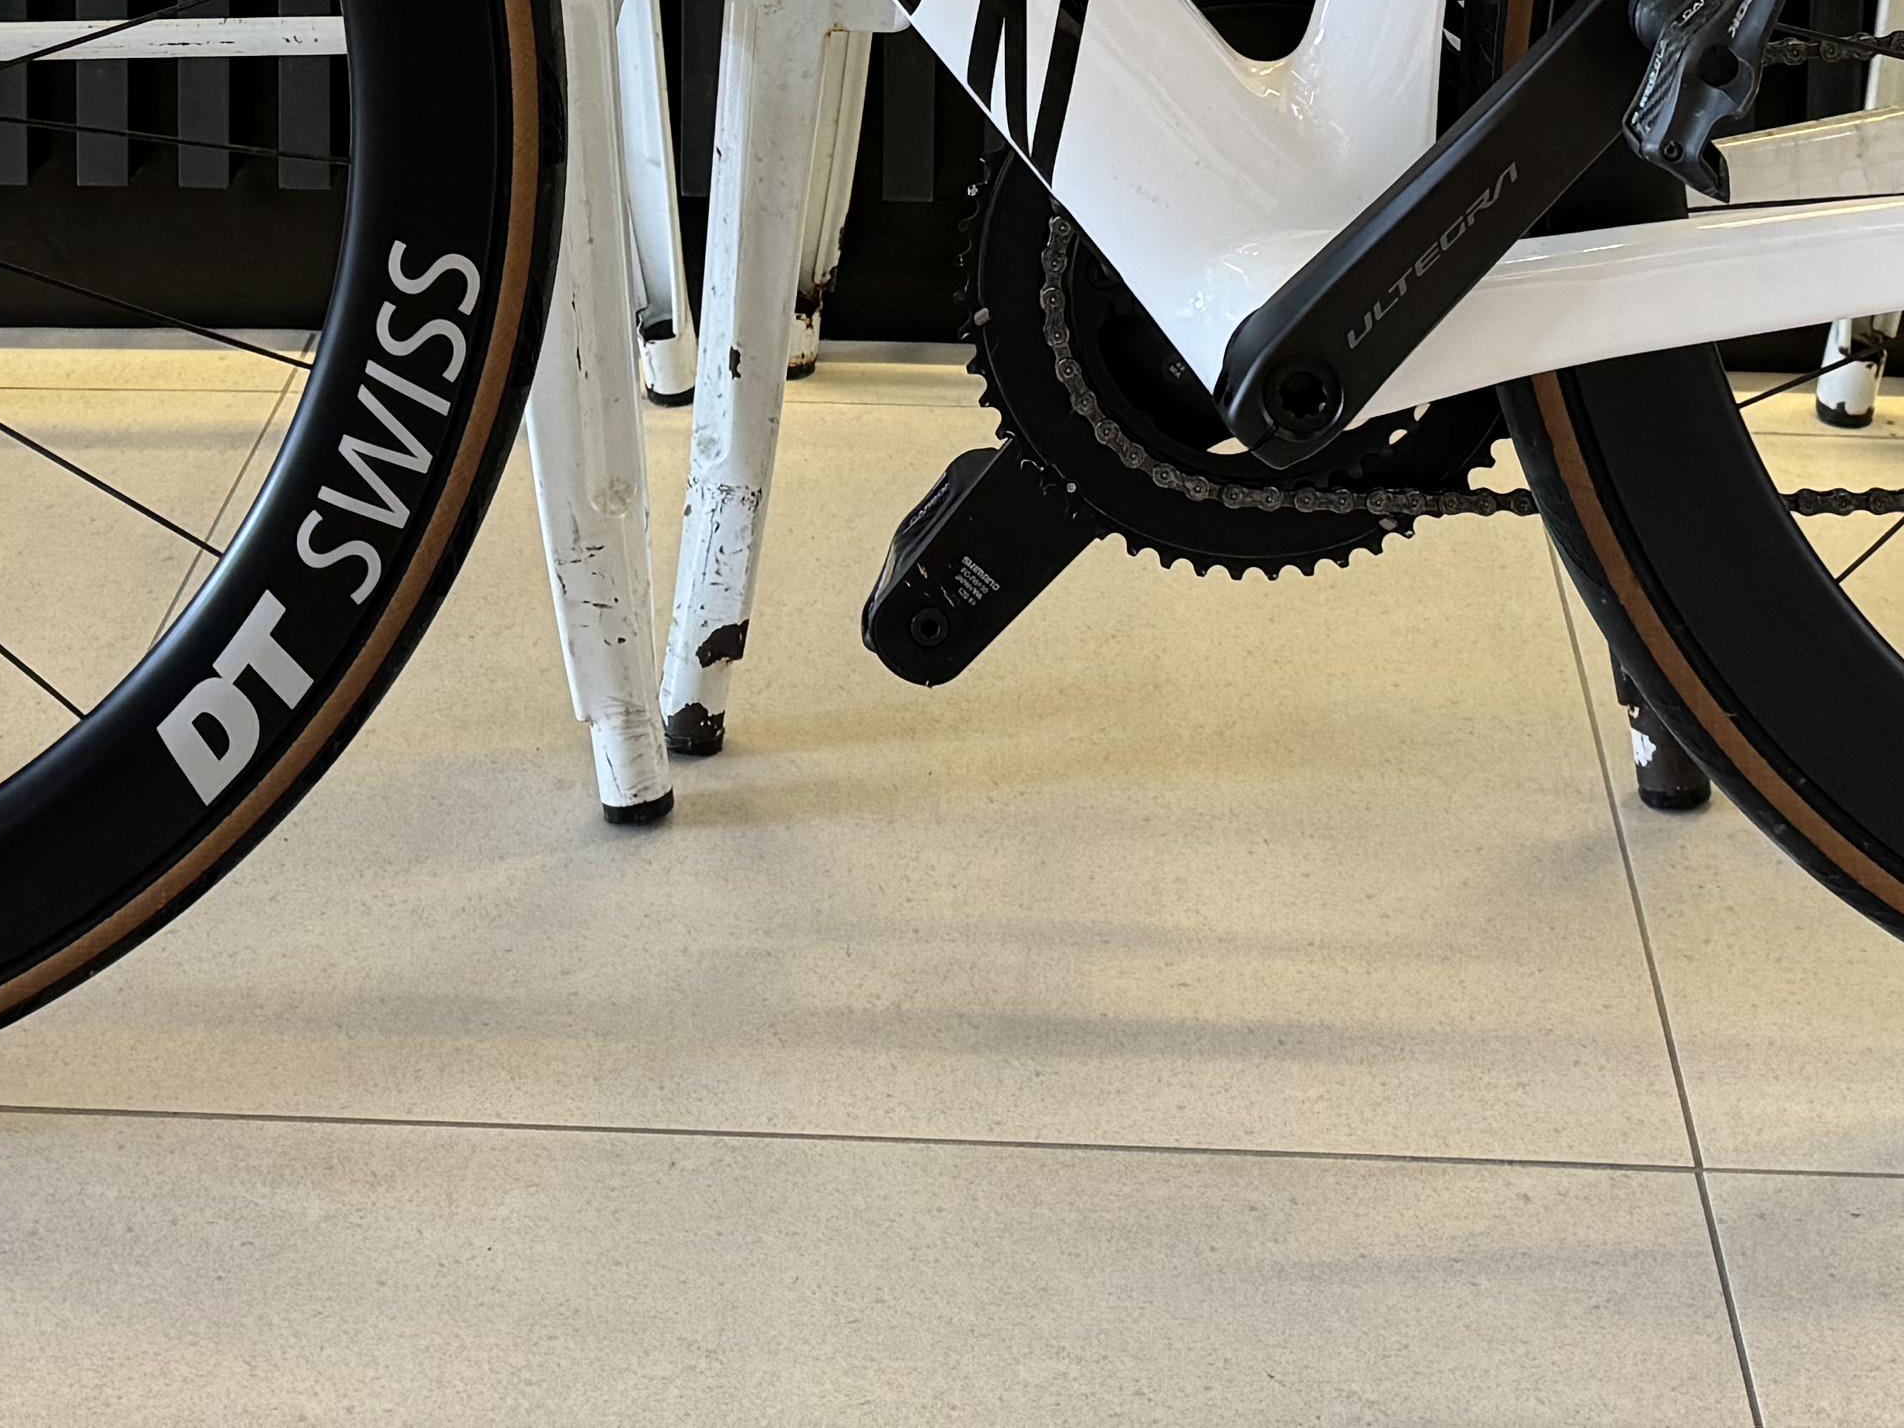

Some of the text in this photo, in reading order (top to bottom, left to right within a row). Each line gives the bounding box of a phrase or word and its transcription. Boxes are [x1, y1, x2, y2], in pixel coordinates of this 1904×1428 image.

[1345, 161, 1519, 350] ULTEGRA
[157, 240, 481, 806] DT SWISS
